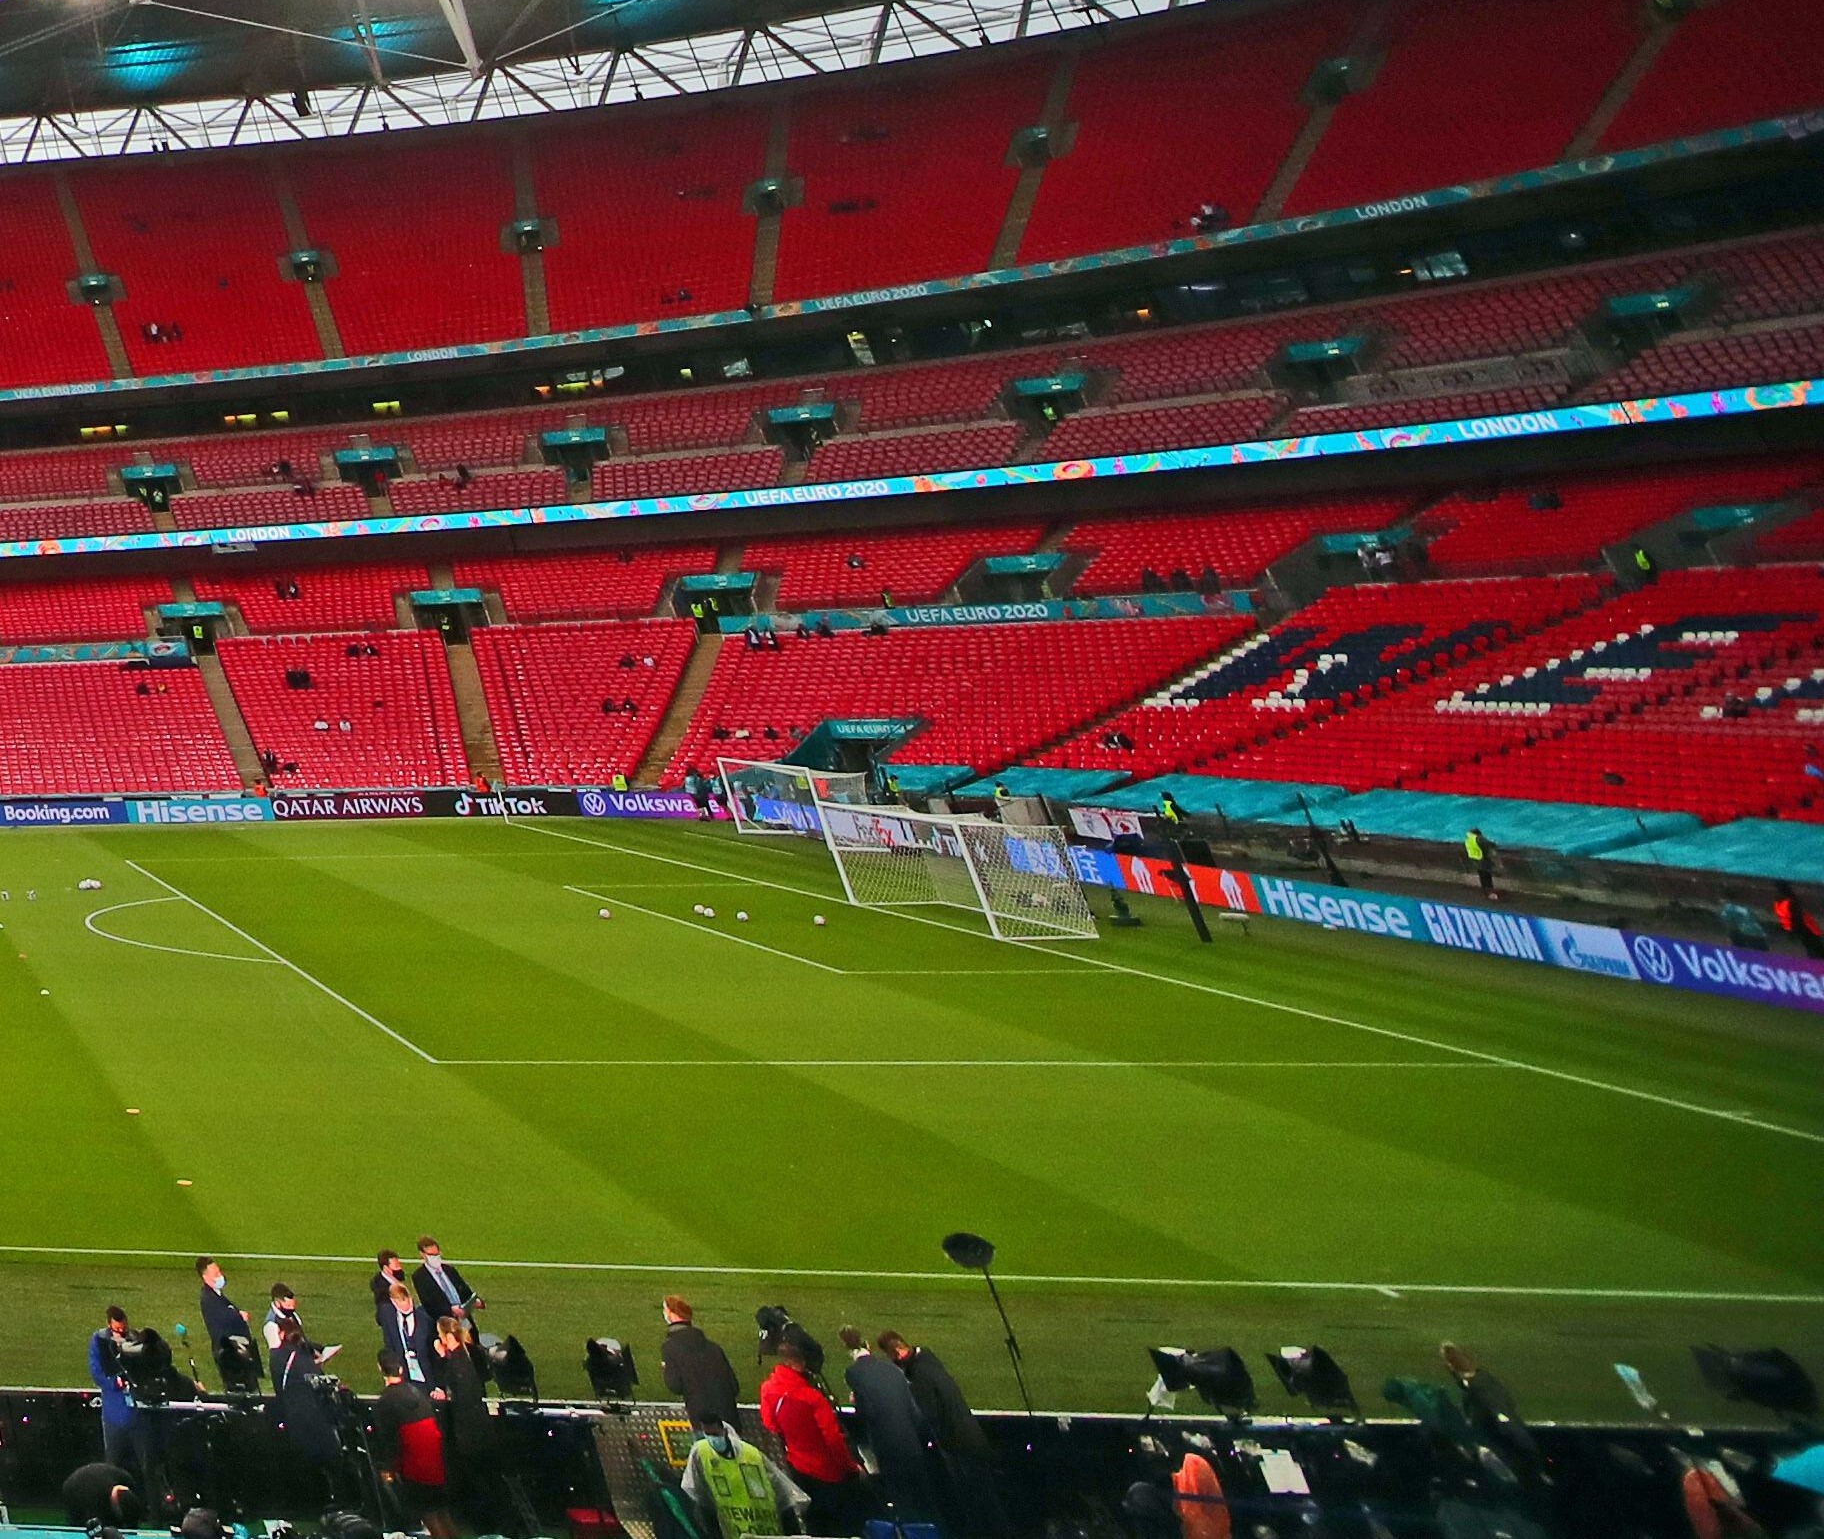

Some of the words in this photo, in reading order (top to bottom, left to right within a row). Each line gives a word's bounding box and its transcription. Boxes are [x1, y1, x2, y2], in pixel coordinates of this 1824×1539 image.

[1355, 194, 1428, 220] LONDON
[816, 296, 853, 311] UEFA
[853, 291, 891, 306] EURO
[892, 285, 927, 301] 2020
[407, 348, 458, 362] LONDON
[1457, 411, 1559, 440] LONDON
[744, 490, 791, 506] UEFA
[791, 485, 843, 503] EURO
[845, 481, 888, 498] 2020
[227, 526, 290, 543] LONDON
[905, 607, 952, 625] UEFA
[953, 605, 1002, 622] EURO
[1003, 603, 1048, 621] 2020
[4, 804, 109, 825] Booking.com
[137, 801, 262, 824] Hisense
[273, 797, 337, 818] QATAR
[342, 795, 423, 816] AIRWAYS
[476, 795, 547, 816] TikTok
[612, 793, 724, 814] Volkswae
[1259, 877, 1412, 939] Hisense
[1420, 902, 1544, 961] GAZPROM
